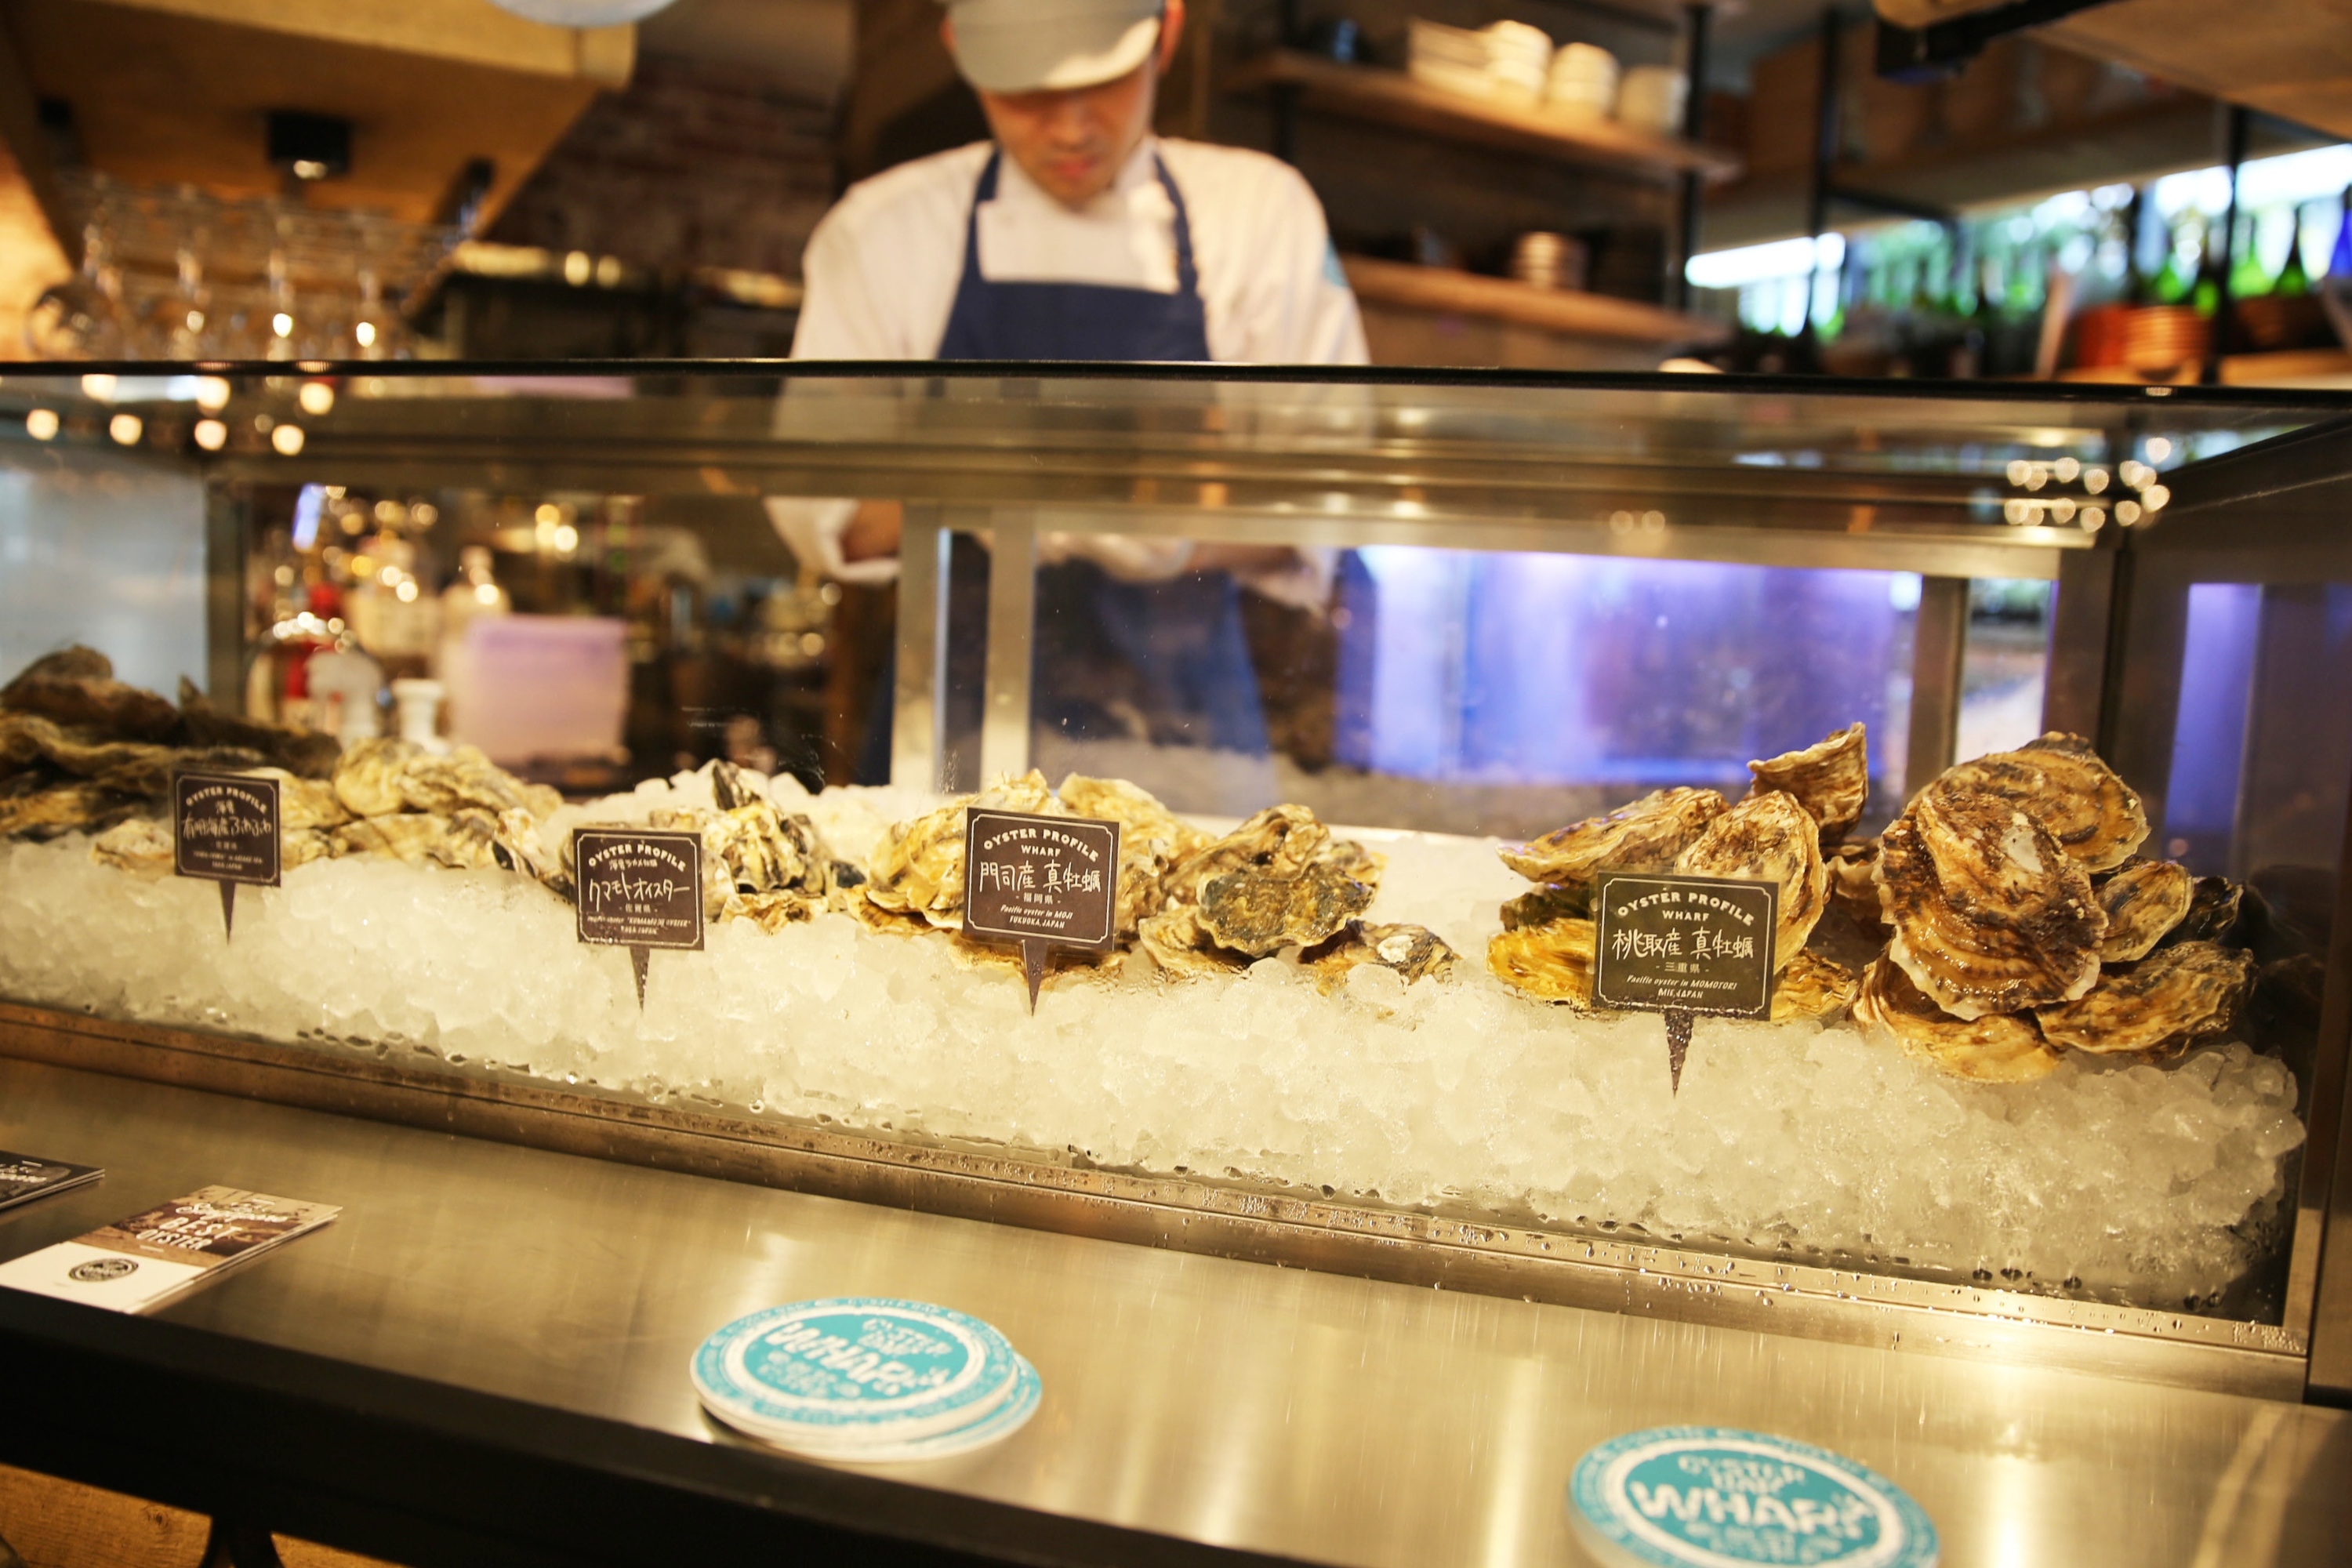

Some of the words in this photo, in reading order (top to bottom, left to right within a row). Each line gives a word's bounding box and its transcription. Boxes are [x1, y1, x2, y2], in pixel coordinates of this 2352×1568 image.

[186, 786, 223, 807] OYSTER
[226, 786, 267, 814] PROFILE
[588, 844, 633, 866] OYSTER
[637, 844, 686, 872] PROFILE
[983, 828, 1036, 850] OYSTER
[1043, 829, 1099, 862] PROFILE
[1021, 844, 1061, 857] WHARF
[979, 860, 1036, 893] 門司産
[589, 872, 690, 912] クマモトオイスター
[1000, 904, 1022, 913] Pacific
[1054, 910, 1073, 920] MOJI
[1617, 891, 1681, 916] OYSTER
[1688, 892, 1755, 926] PROFILE
[1662, 909, 1710, 921] WHARF
[1612, 927, 1682, 960] 桃取産
[1627, 975, 1653, 984] Pacific
[1653, 978, 1679, 986] oyster
[1690, 979, 1737, 990] MOMOTORI
[136, 1229, 212, 1250] OYSTER
[159, 1217, 242, 1240] BEST
